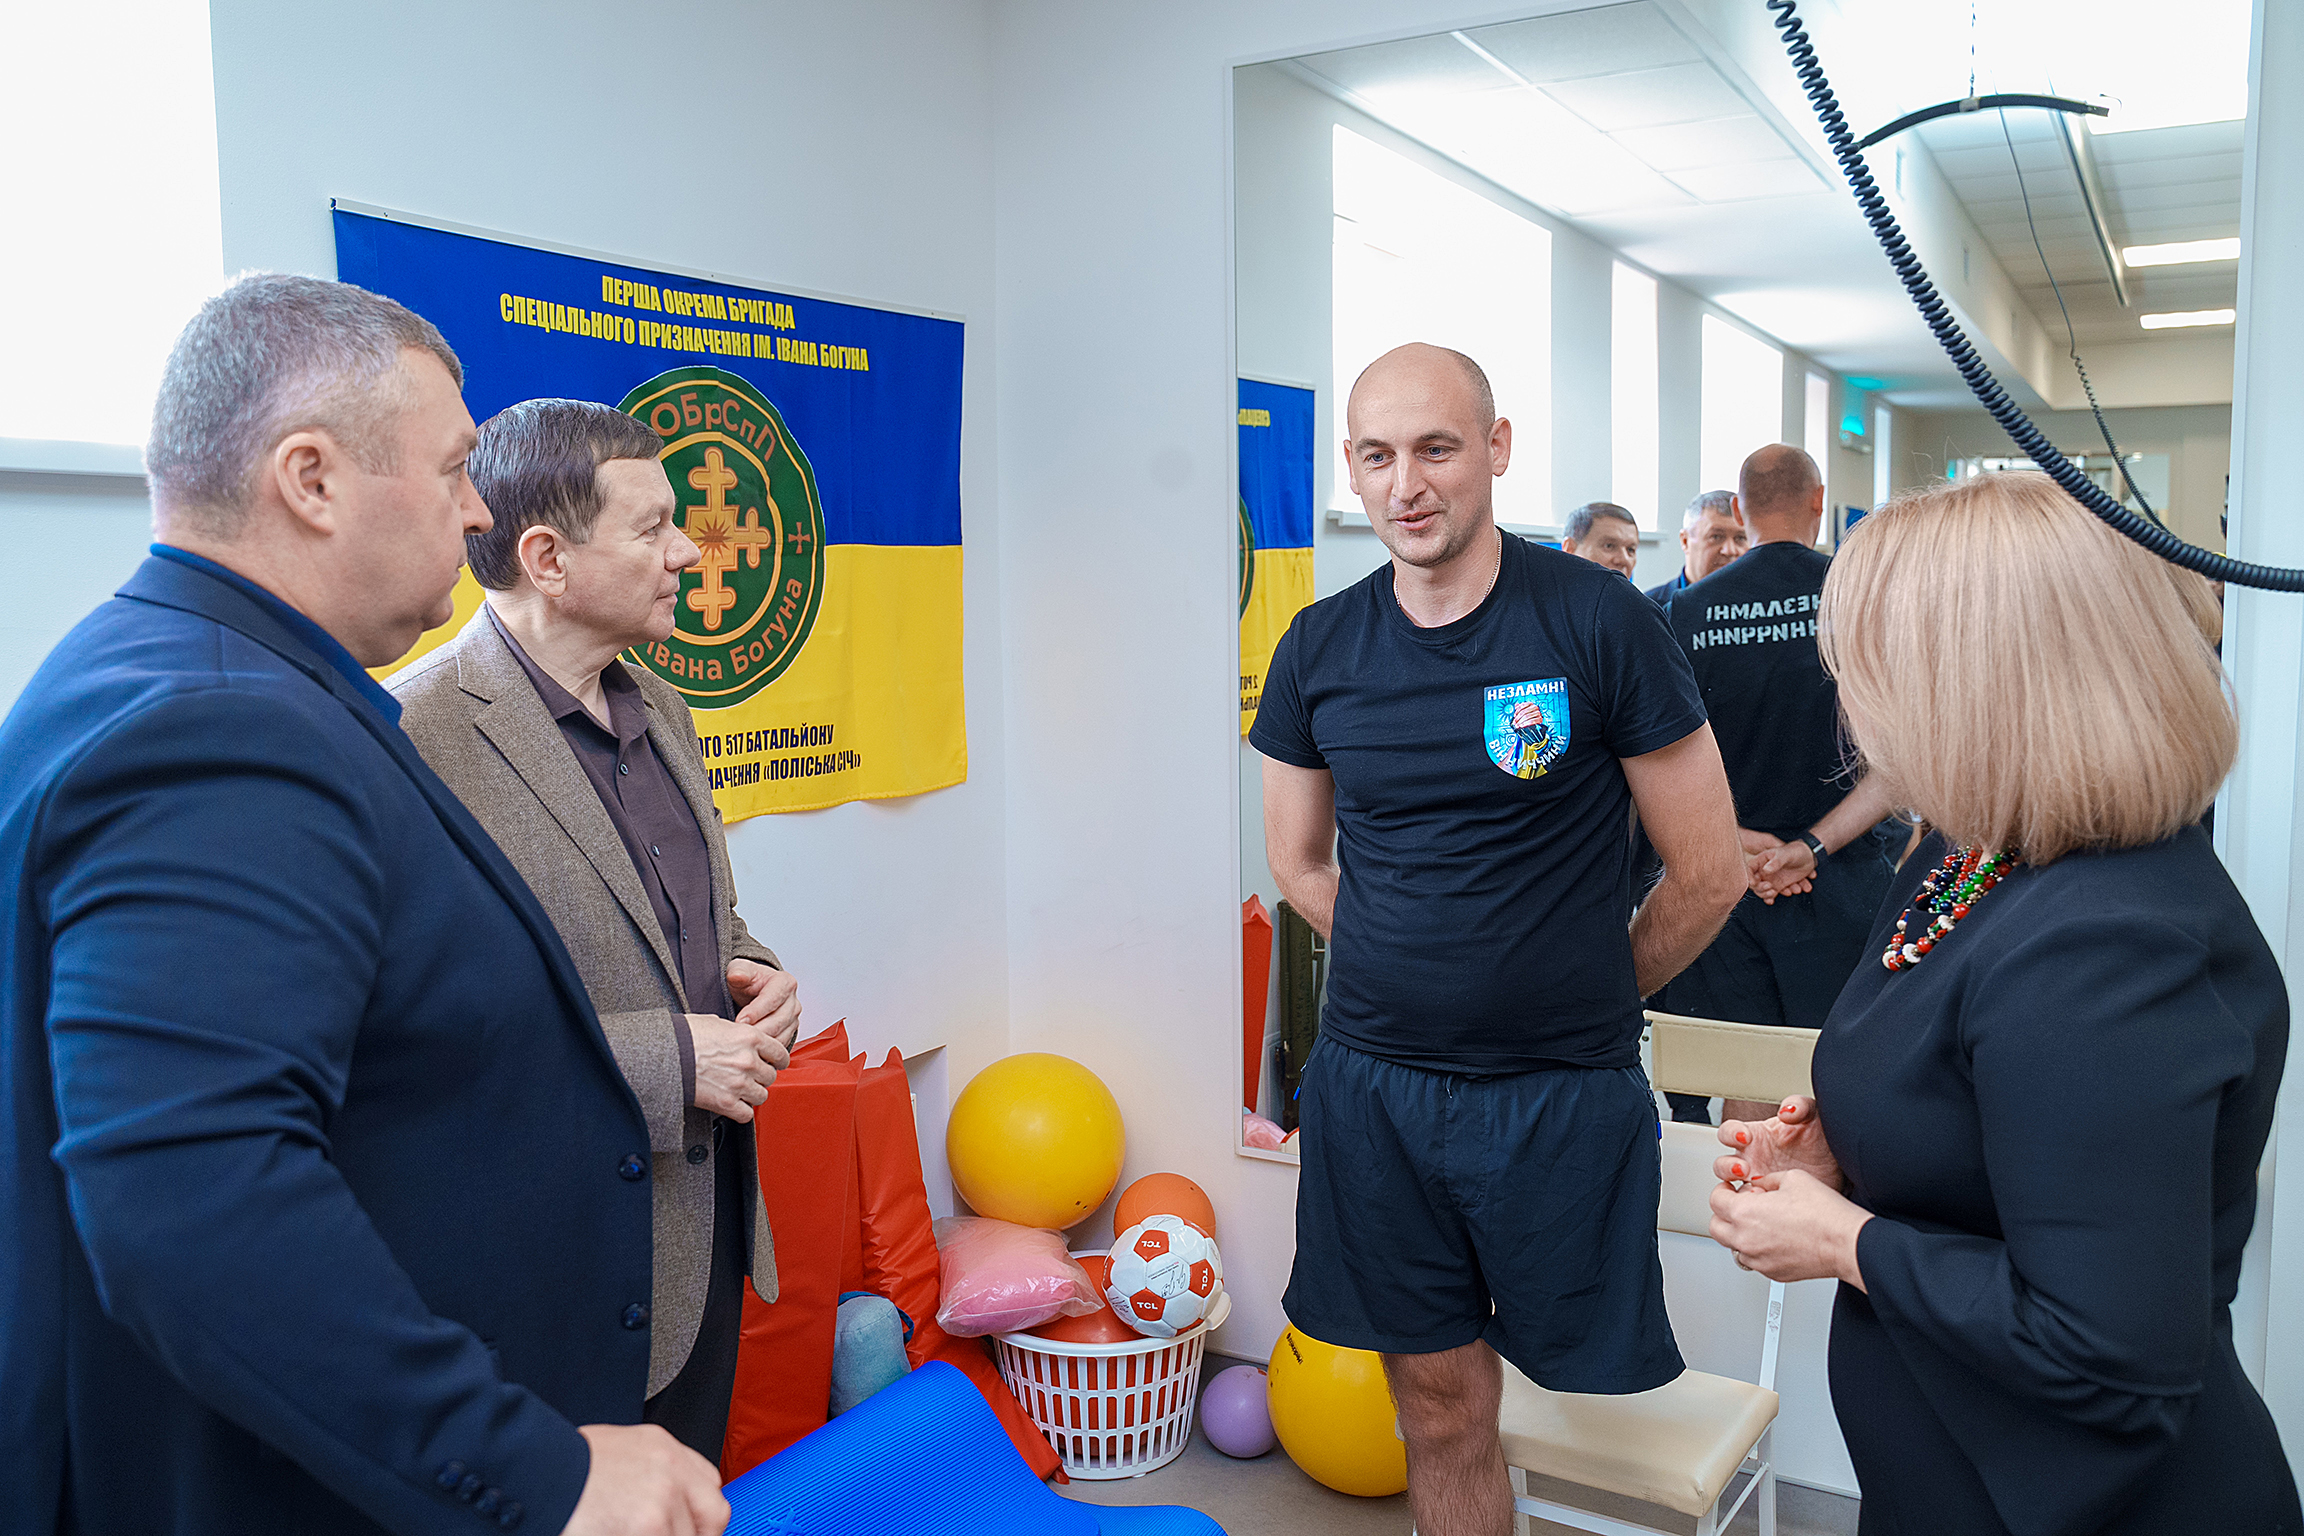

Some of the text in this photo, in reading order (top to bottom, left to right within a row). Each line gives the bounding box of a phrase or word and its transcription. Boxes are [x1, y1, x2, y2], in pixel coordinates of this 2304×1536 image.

[602, 275, 796, 331] ПЕРША ОКРЕМА БРИГАДА
[500, 293, 870, 372] СПЕЦІАЛЬНОГО ПРИЗНАЧЕННЯ ІМ. ІВАНА БОГУНА
[729, 578, 803, 675] Богуна
[1487, 680, 1565, 701] НЕЗЛАМНІ
[725, 732, 744, 756] 517
[746, 722, 834, 753] БАТАЛЬЙОНУ
[1141, 1240, 1161, 1248] TCL
[1137, 1301, 1158, 1310] TCL
